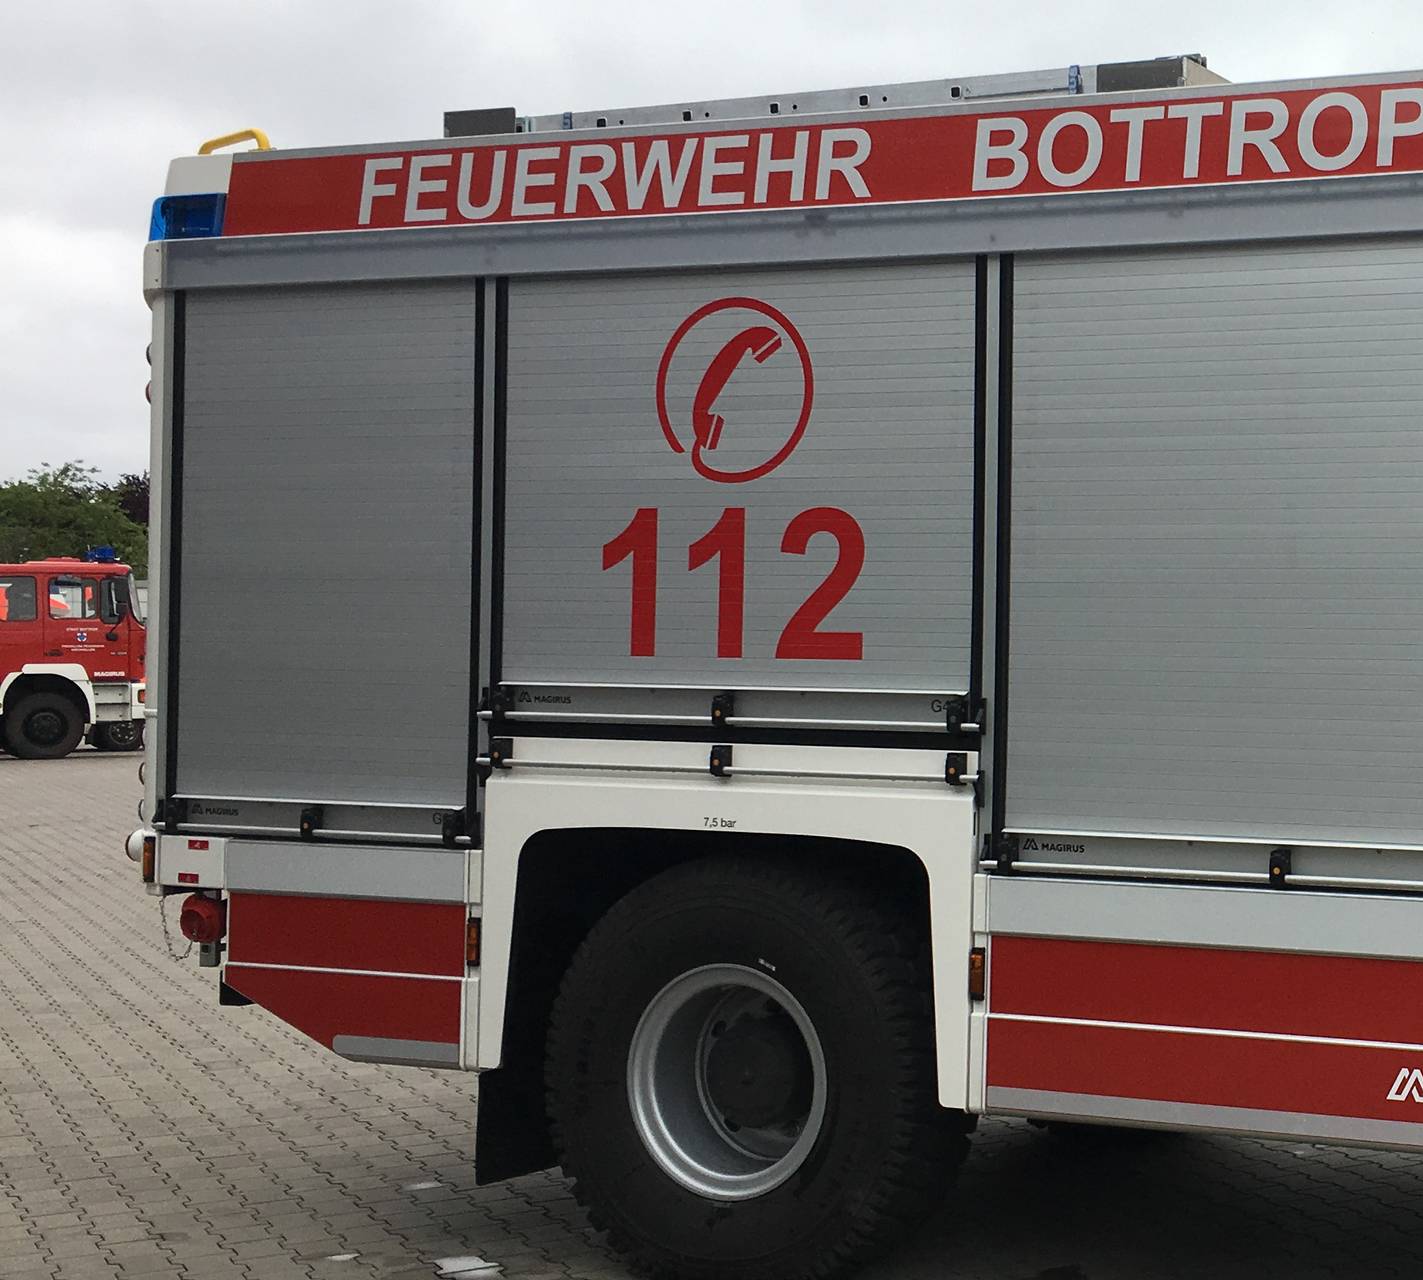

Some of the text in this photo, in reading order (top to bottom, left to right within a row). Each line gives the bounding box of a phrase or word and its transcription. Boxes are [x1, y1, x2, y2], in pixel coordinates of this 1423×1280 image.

[357, 127, 873, 225] FEUERWEHR
[602, 506, 866, 661] 112
[534, 695, 572, 705] MAGIRUS
[205, 807, 240, 817] MAGIRUS
[703, 816, 737, 828] 7,5 bar
[1041, 842, 1086, 854] MAGIRUS
